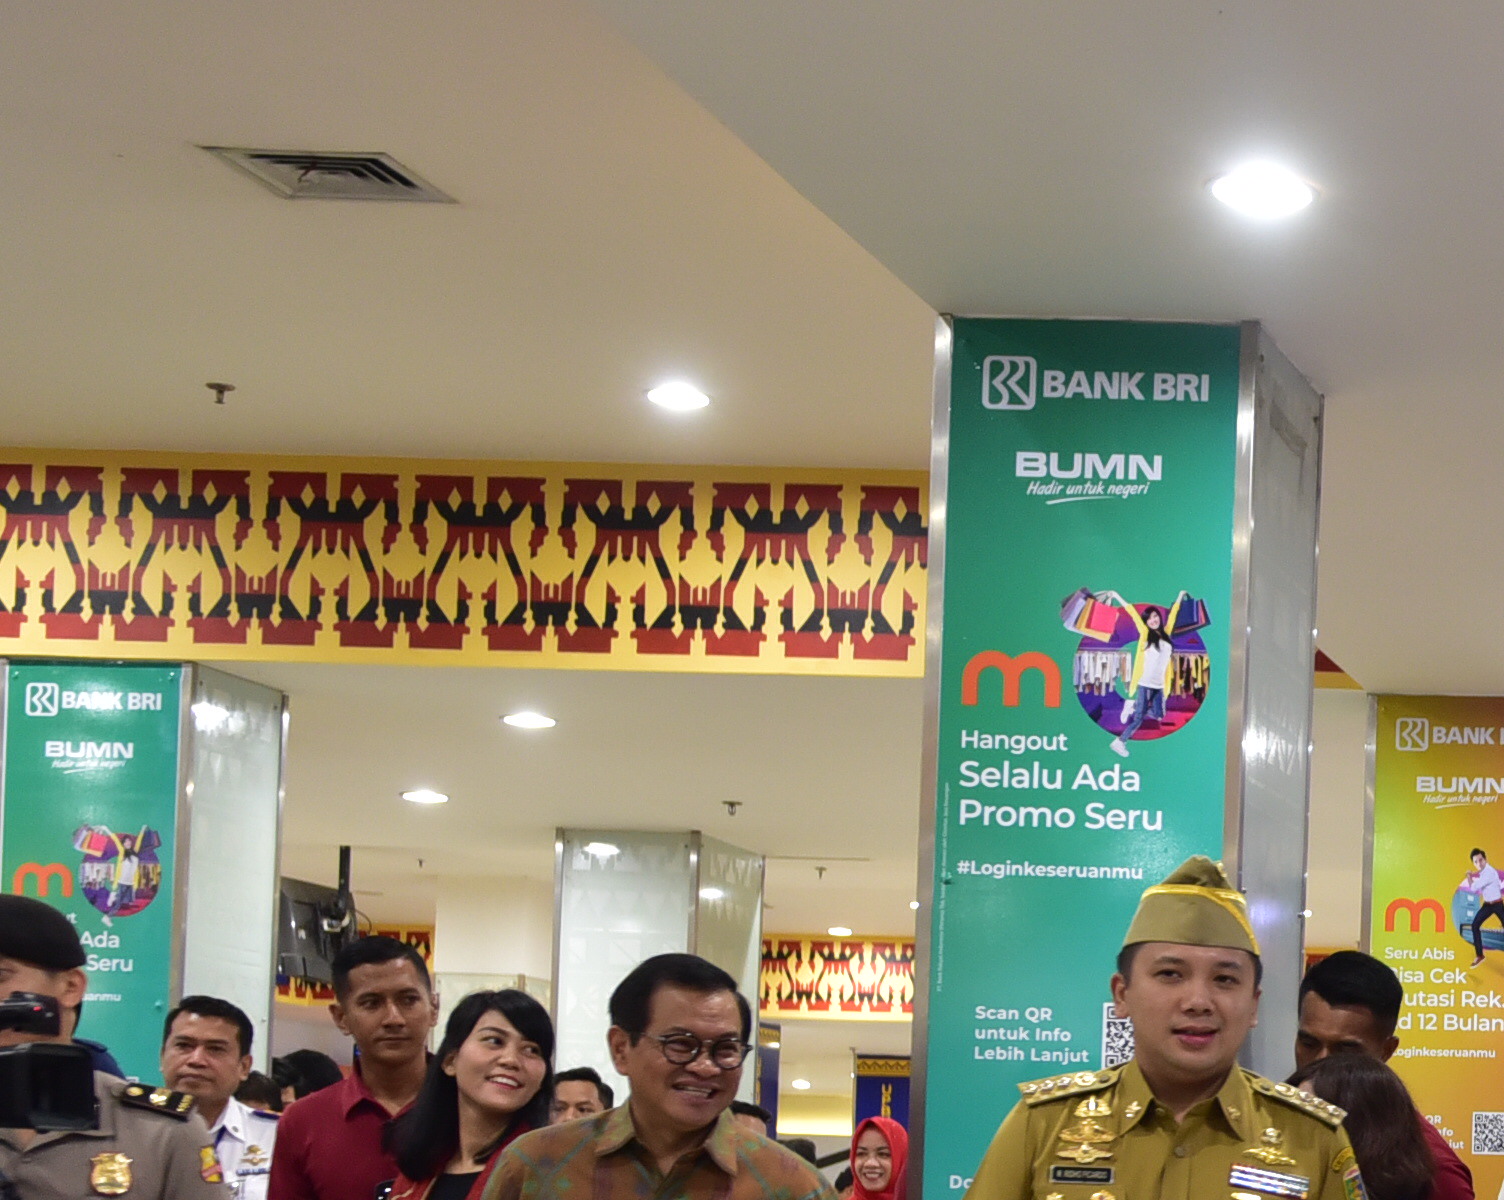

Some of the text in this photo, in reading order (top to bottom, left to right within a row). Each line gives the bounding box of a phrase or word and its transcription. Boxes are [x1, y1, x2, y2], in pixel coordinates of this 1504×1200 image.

[1043, 370, 1209, 402] BANK BRI
[1015, 451, 1162, 480] BUMN
[1026, 481, 1150, 498] Hadir untuk negeri
[62, 691, 161, 710] BANK BRI
[961, 730, 1068, 753] Hangout
[1433, 727, 1494, 744] BANK
[45, 741, 134, 759] BUMN
[960, 761, 1140, 791] Selalu Ada
[960, 799, 1162, 831] Promo Seru
[957, 860, 1143, 880] #Loginkeseruanmu
[80, 931, 119, 948] Ada
[1385, 947, 1454, 960] Seru Abis
[85, 954, 132, 973] Seru
[1430, 968, 1466, 983] Cek
[1404, 990, 1454, 1007] utasi
[976, 1006, 1052, 1023] Scan QR
[1418, 1014, 1437, 1030] 12
[1444, 1014, 1504, 1031] Bulan
[975, 1027, 1071, 1041] untuk Info
[975, 1046, 1089, 1065] Lebih Lanjut
[1394, 1047, 1496, 1058] oginkeseruanmu
